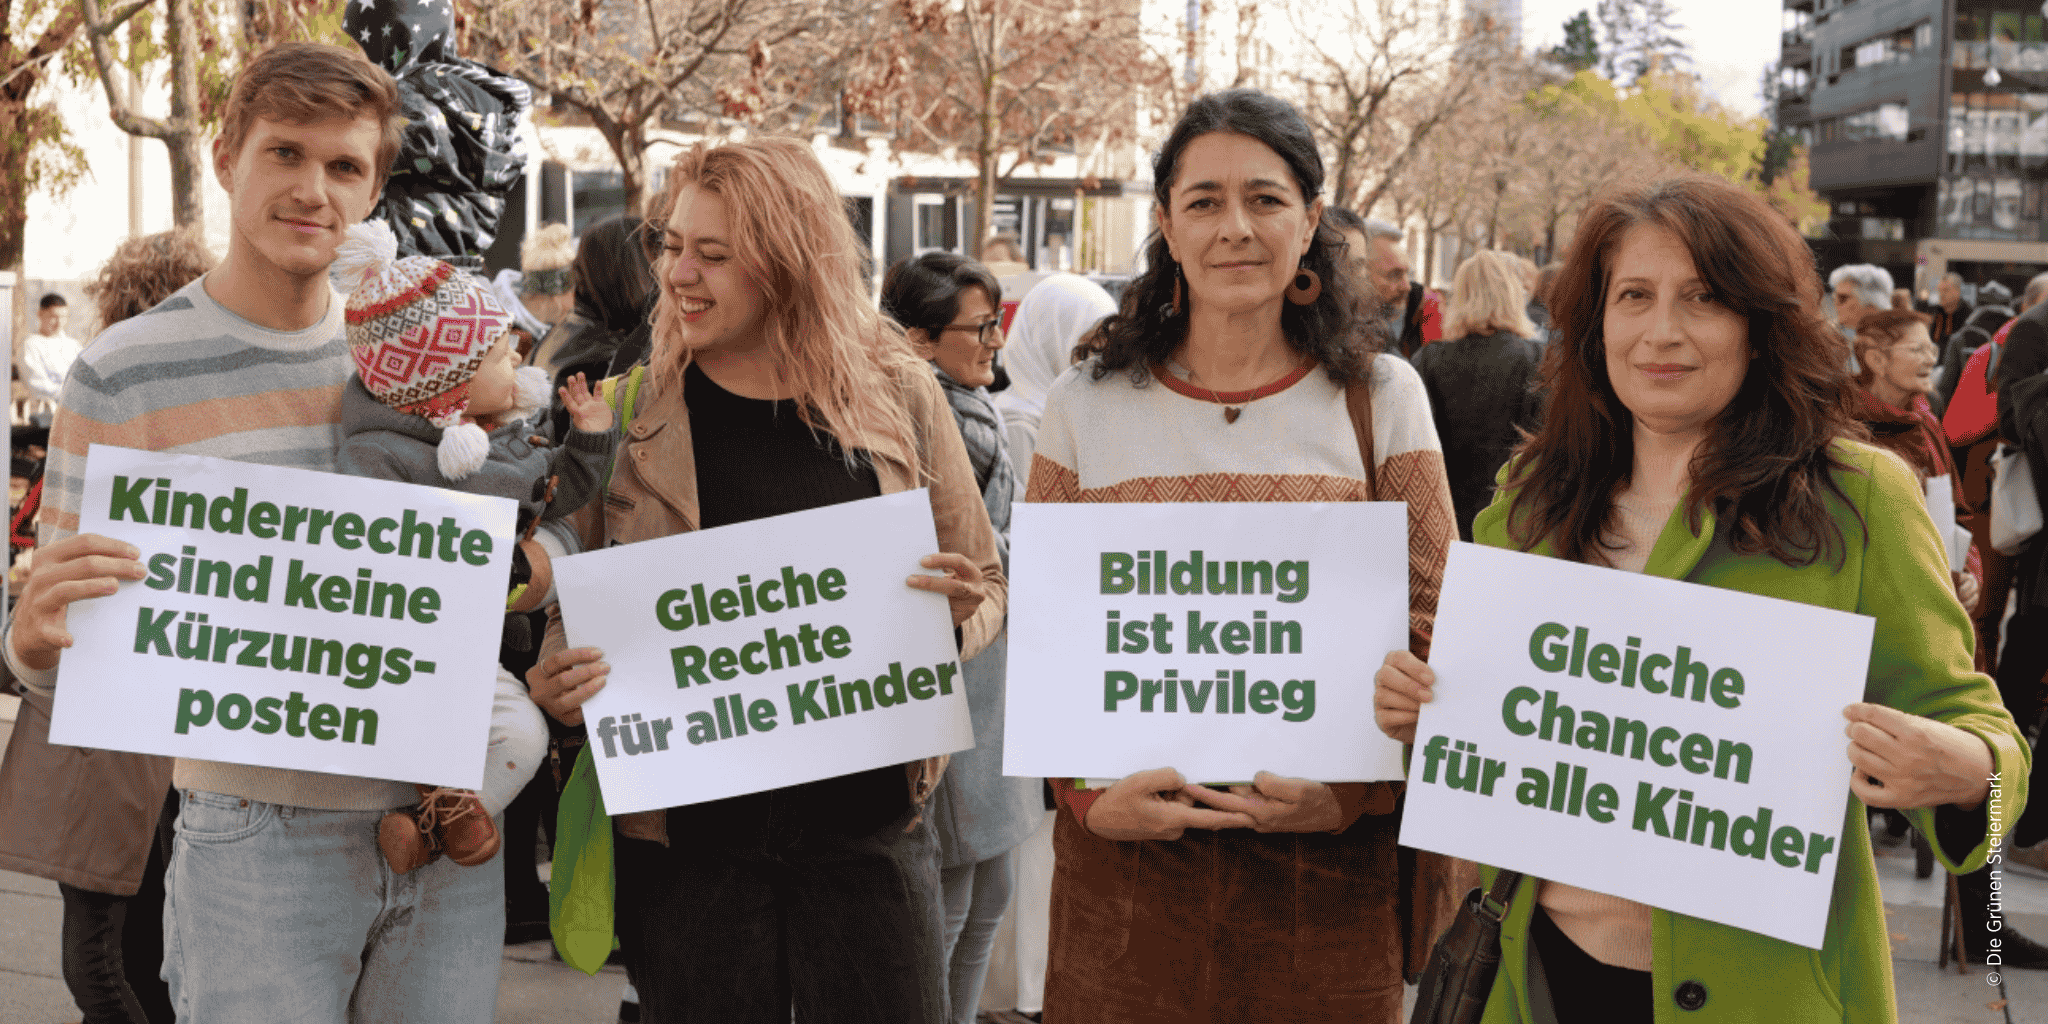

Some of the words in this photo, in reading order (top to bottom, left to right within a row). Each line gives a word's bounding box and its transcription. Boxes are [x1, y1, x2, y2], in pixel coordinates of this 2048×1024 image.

[109, 475, 493, 566] Kinderrechte
[144, 546, 273, 603] sind
[284, 559, 441, 624] keine
[655, 566, 847, 632] Gleiche
[1100, 550, 1309, 603] Bildung
[134, 607, 436, 689] Kürzungs-
[670, 623, 852, 689] Rechte
[1107, 611, 1173, 654] ist
[1187, 611, 1302, 655] kein
[1529, 622, 1745, 709] Gleiche
[175, 688, 378, 746] posten
[597, 714, 673, 758] für
[686, 693, 777, 745] alle
[786, 660, 958, 725] Kinder
[1104, 669, 1315, 722] Privileg
[1502, 686, 1753, 784] Chancen
[1422, 735, 1506, 797] für
[1516, 761, 1619, 823] alle
[1632, 781, 1835, 874] Kinder
